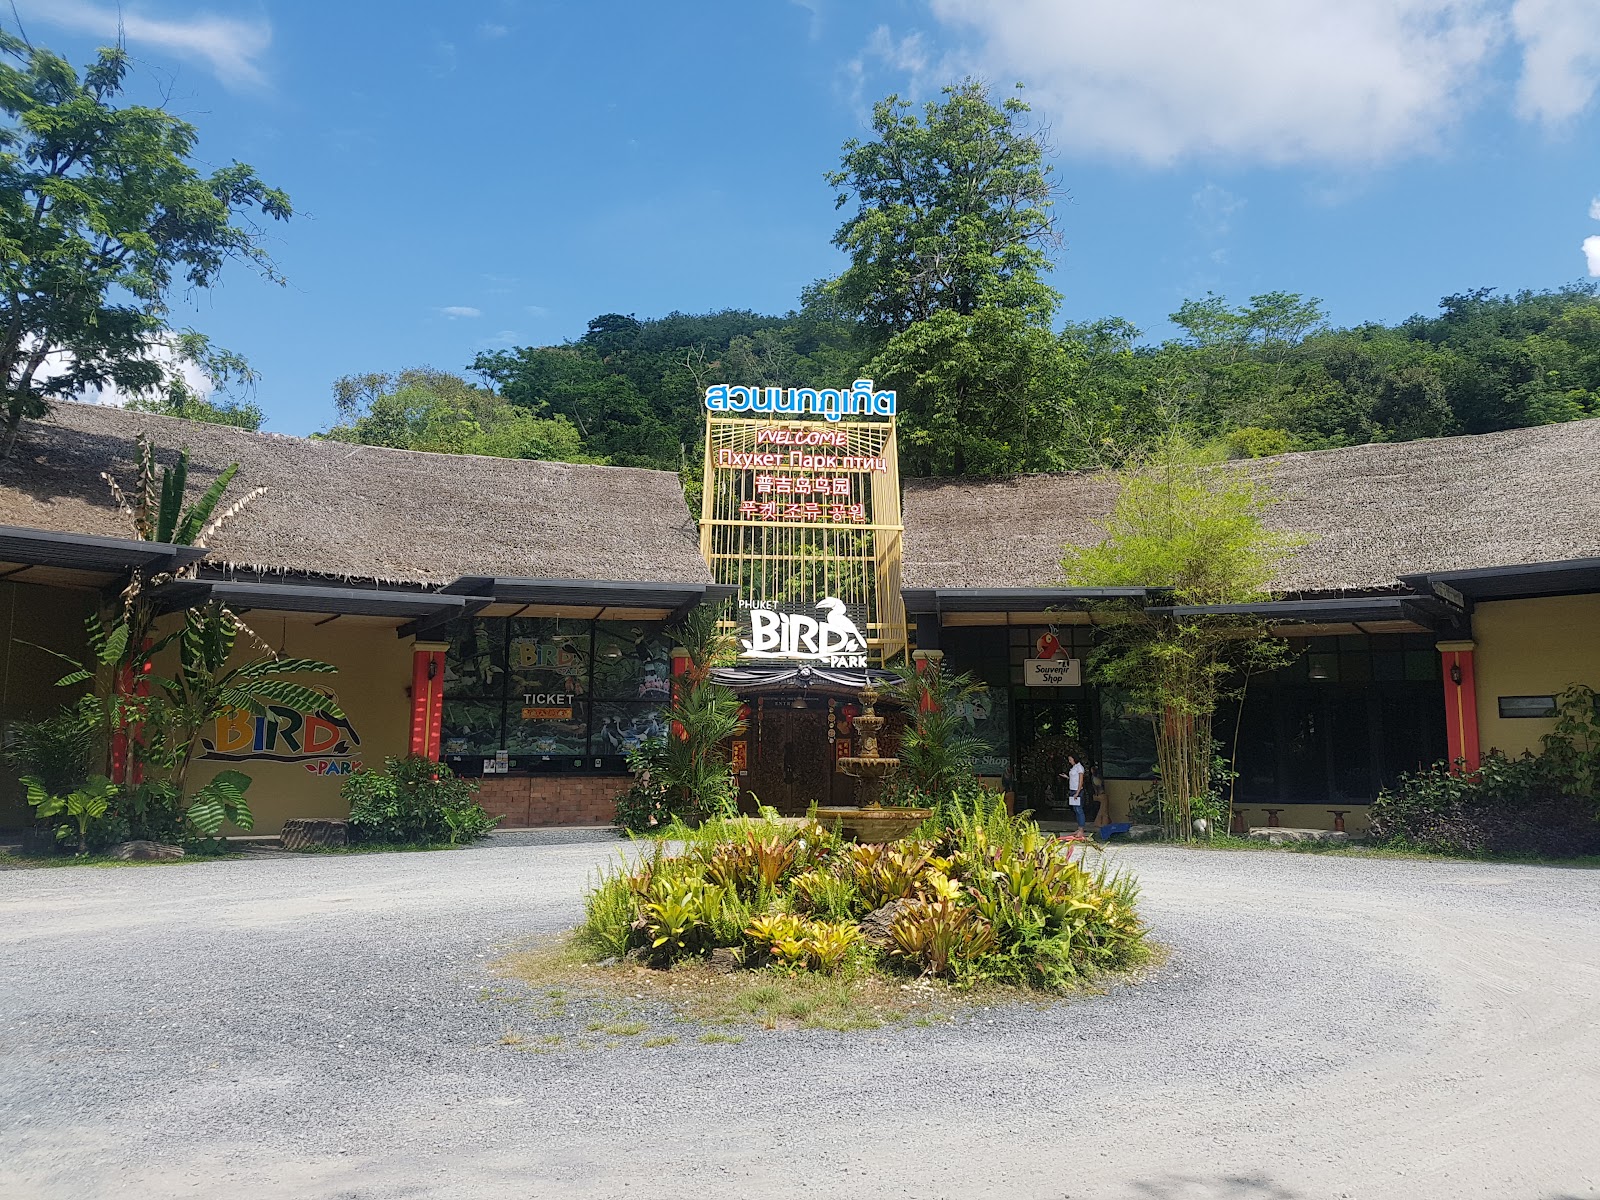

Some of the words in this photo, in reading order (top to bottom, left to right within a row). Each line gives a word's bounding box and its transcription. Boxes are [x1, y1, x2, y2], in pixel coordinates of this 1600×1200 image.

[705, 380, 896, 421] สวนนกภูเก็ต
[756, 429, 848, 447] WELCOME
[718, 449, 784, 470] Пхукет
[789, 451, 837, 469] Парк
[842, 456, 888, 473] птиц
[738, 500, 777, 520] 푸켓
[783, 502, 822, 521] 조류
[828, 503, 865, 522] 공원
[738, 599, 779, 610] PHUKET
[830, 655, 868, 668] PARK
[1035, 664, 1070, 675] Souvenir
[1043, 674, 1063, 683] Shop
[523, 693, 575, 705] TICKET
[982, 755, 1008, 767] Shop
[316, 760, 364, 776] PARK
